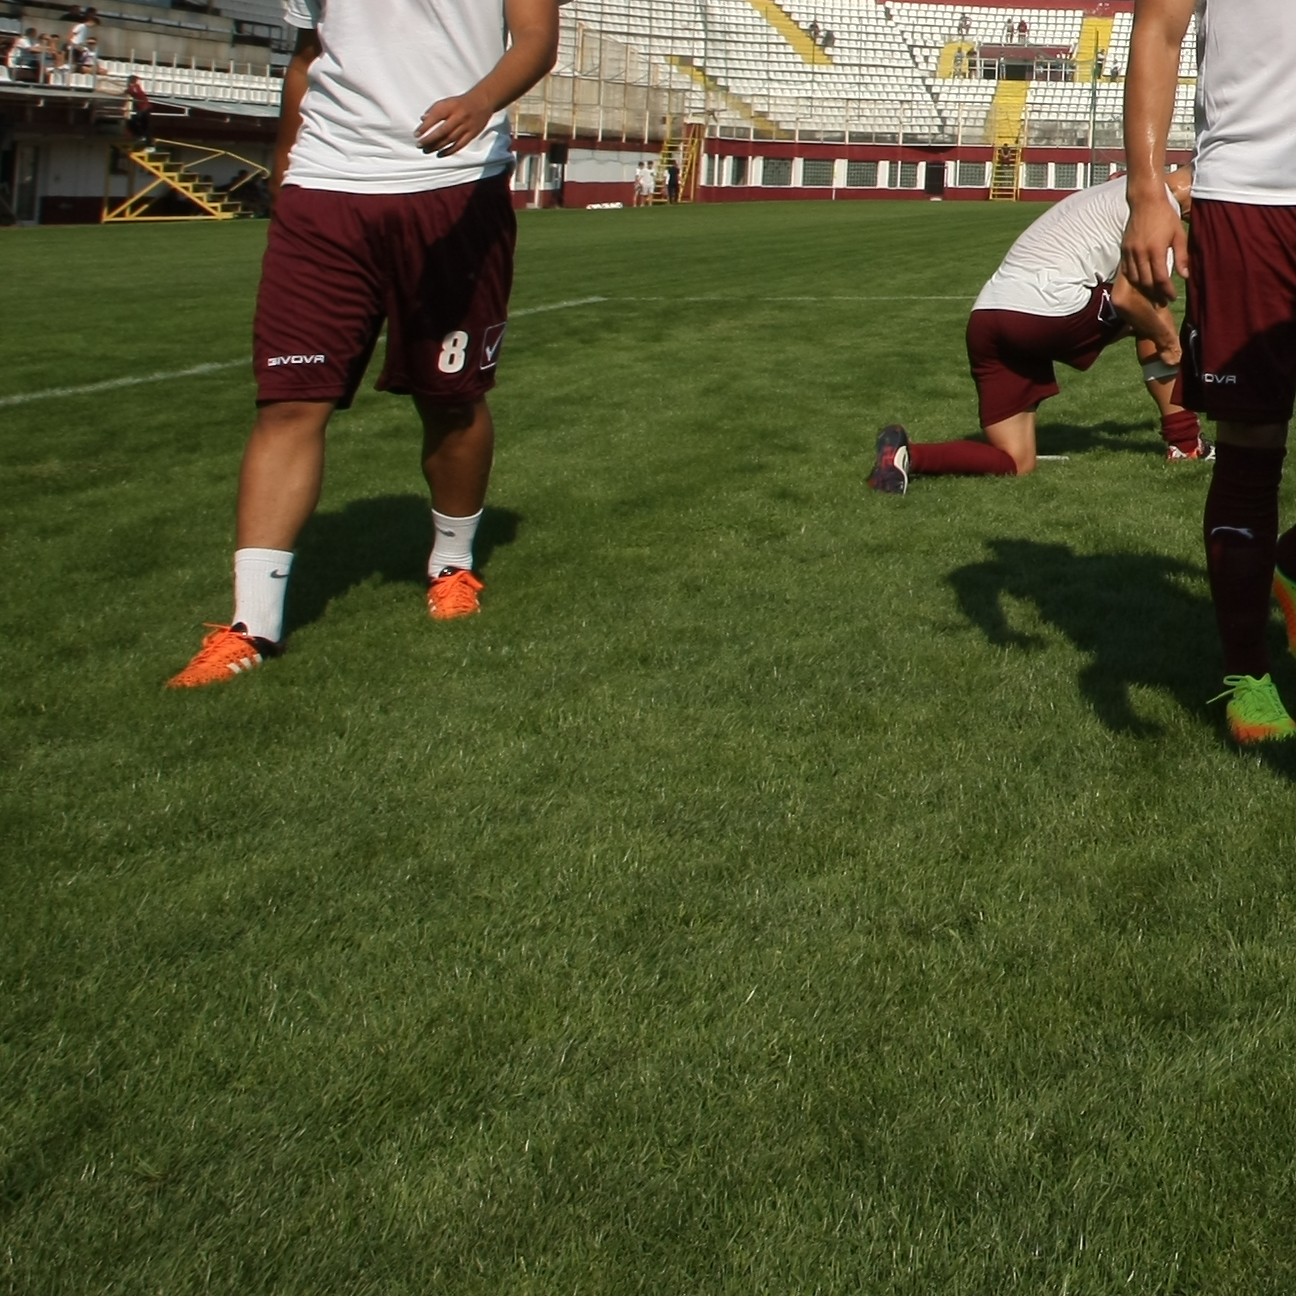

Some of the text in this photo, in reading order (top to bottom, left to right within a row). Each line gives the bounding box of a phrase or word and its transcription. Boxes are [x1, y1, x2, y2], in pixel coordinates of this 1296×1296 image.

[438, 331, 469, 374] 8
[268, 355, 325, 366] GIVOVA
[1202, 373, 1236, 384] OVA
